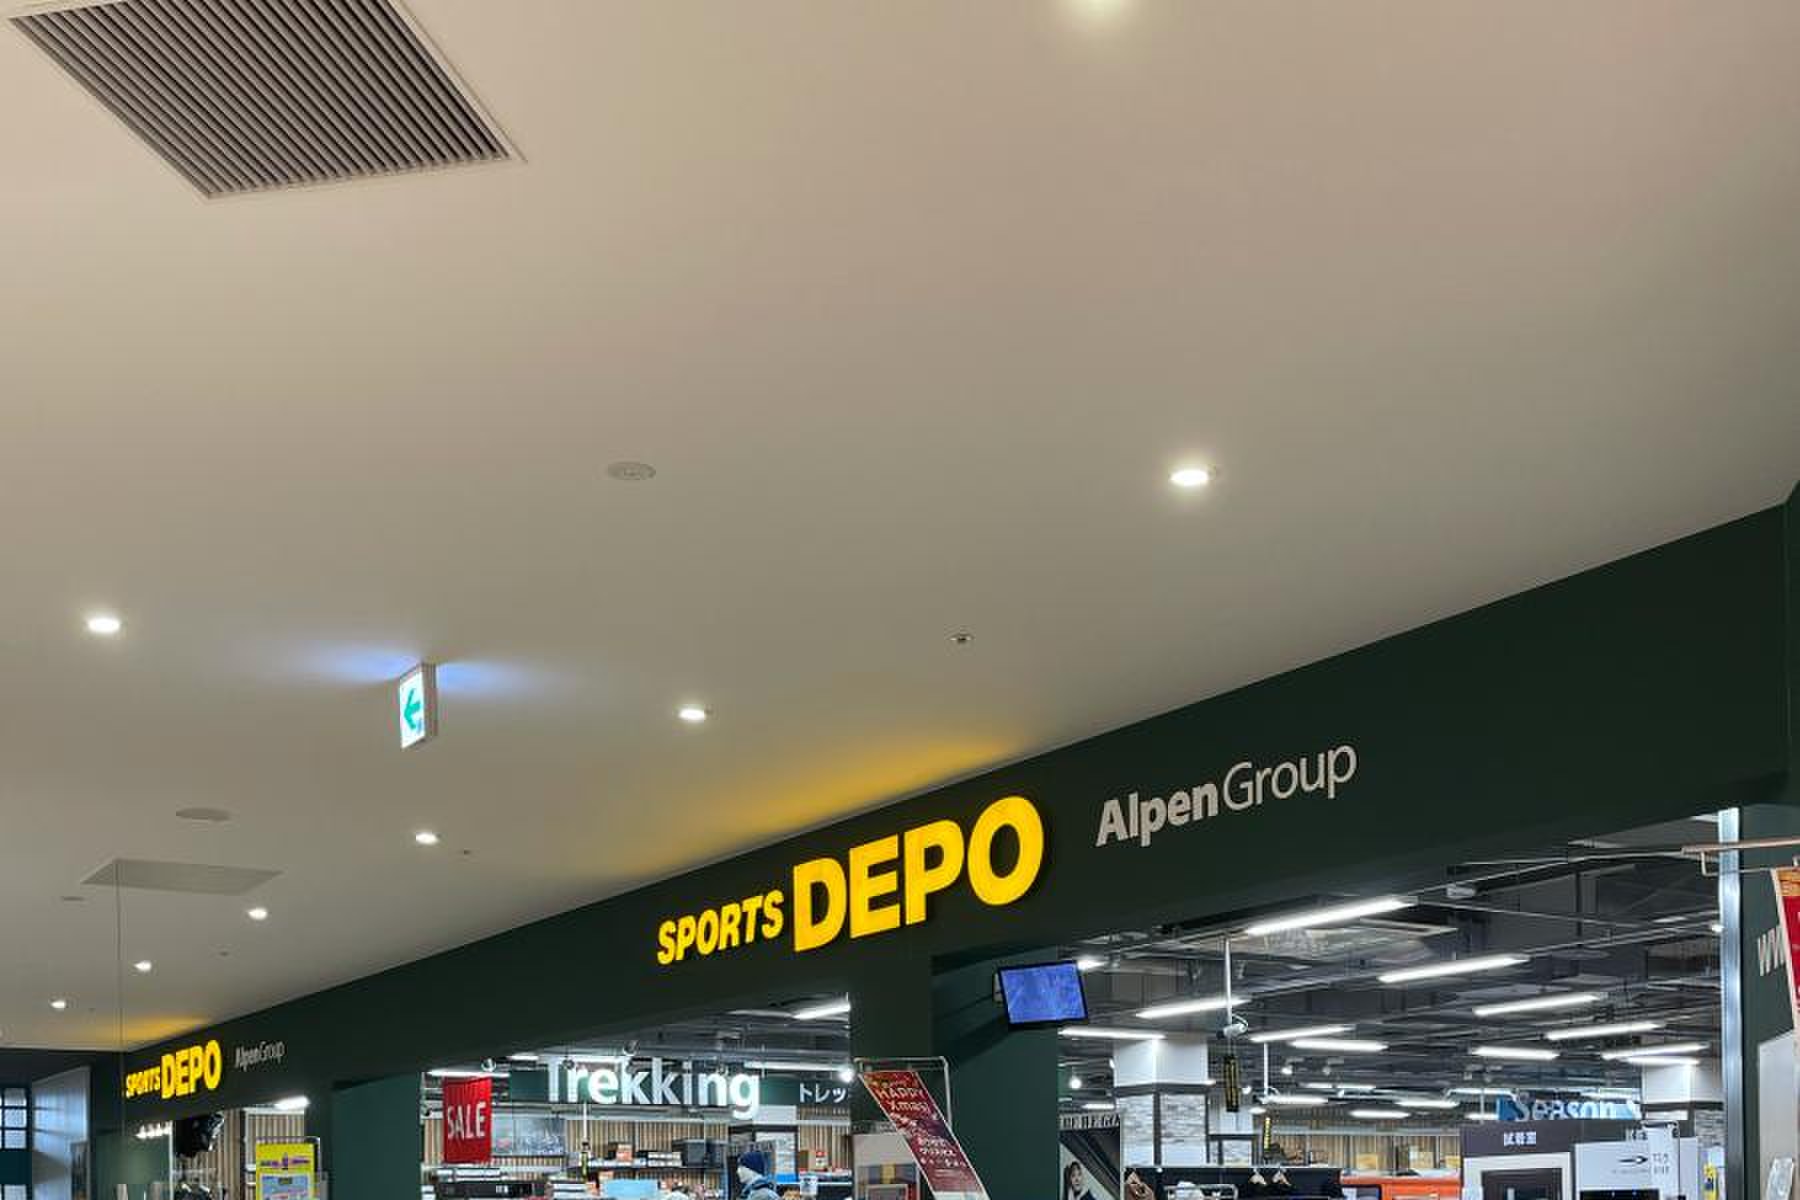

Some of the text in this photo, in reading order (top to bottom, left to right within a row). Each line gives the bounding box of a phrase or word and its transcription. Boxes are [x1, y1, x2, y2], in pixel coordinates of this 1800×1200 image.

[656, 795, 1045, 966] SPORTS DEPO
[125, 1039, 223, 1100] SPORTS DEPO
[545, 1056, 762, 1120] Trekking
[800, 1085, 850, 1105] トレッ
[446, 1101, 486, 1141] SALE
